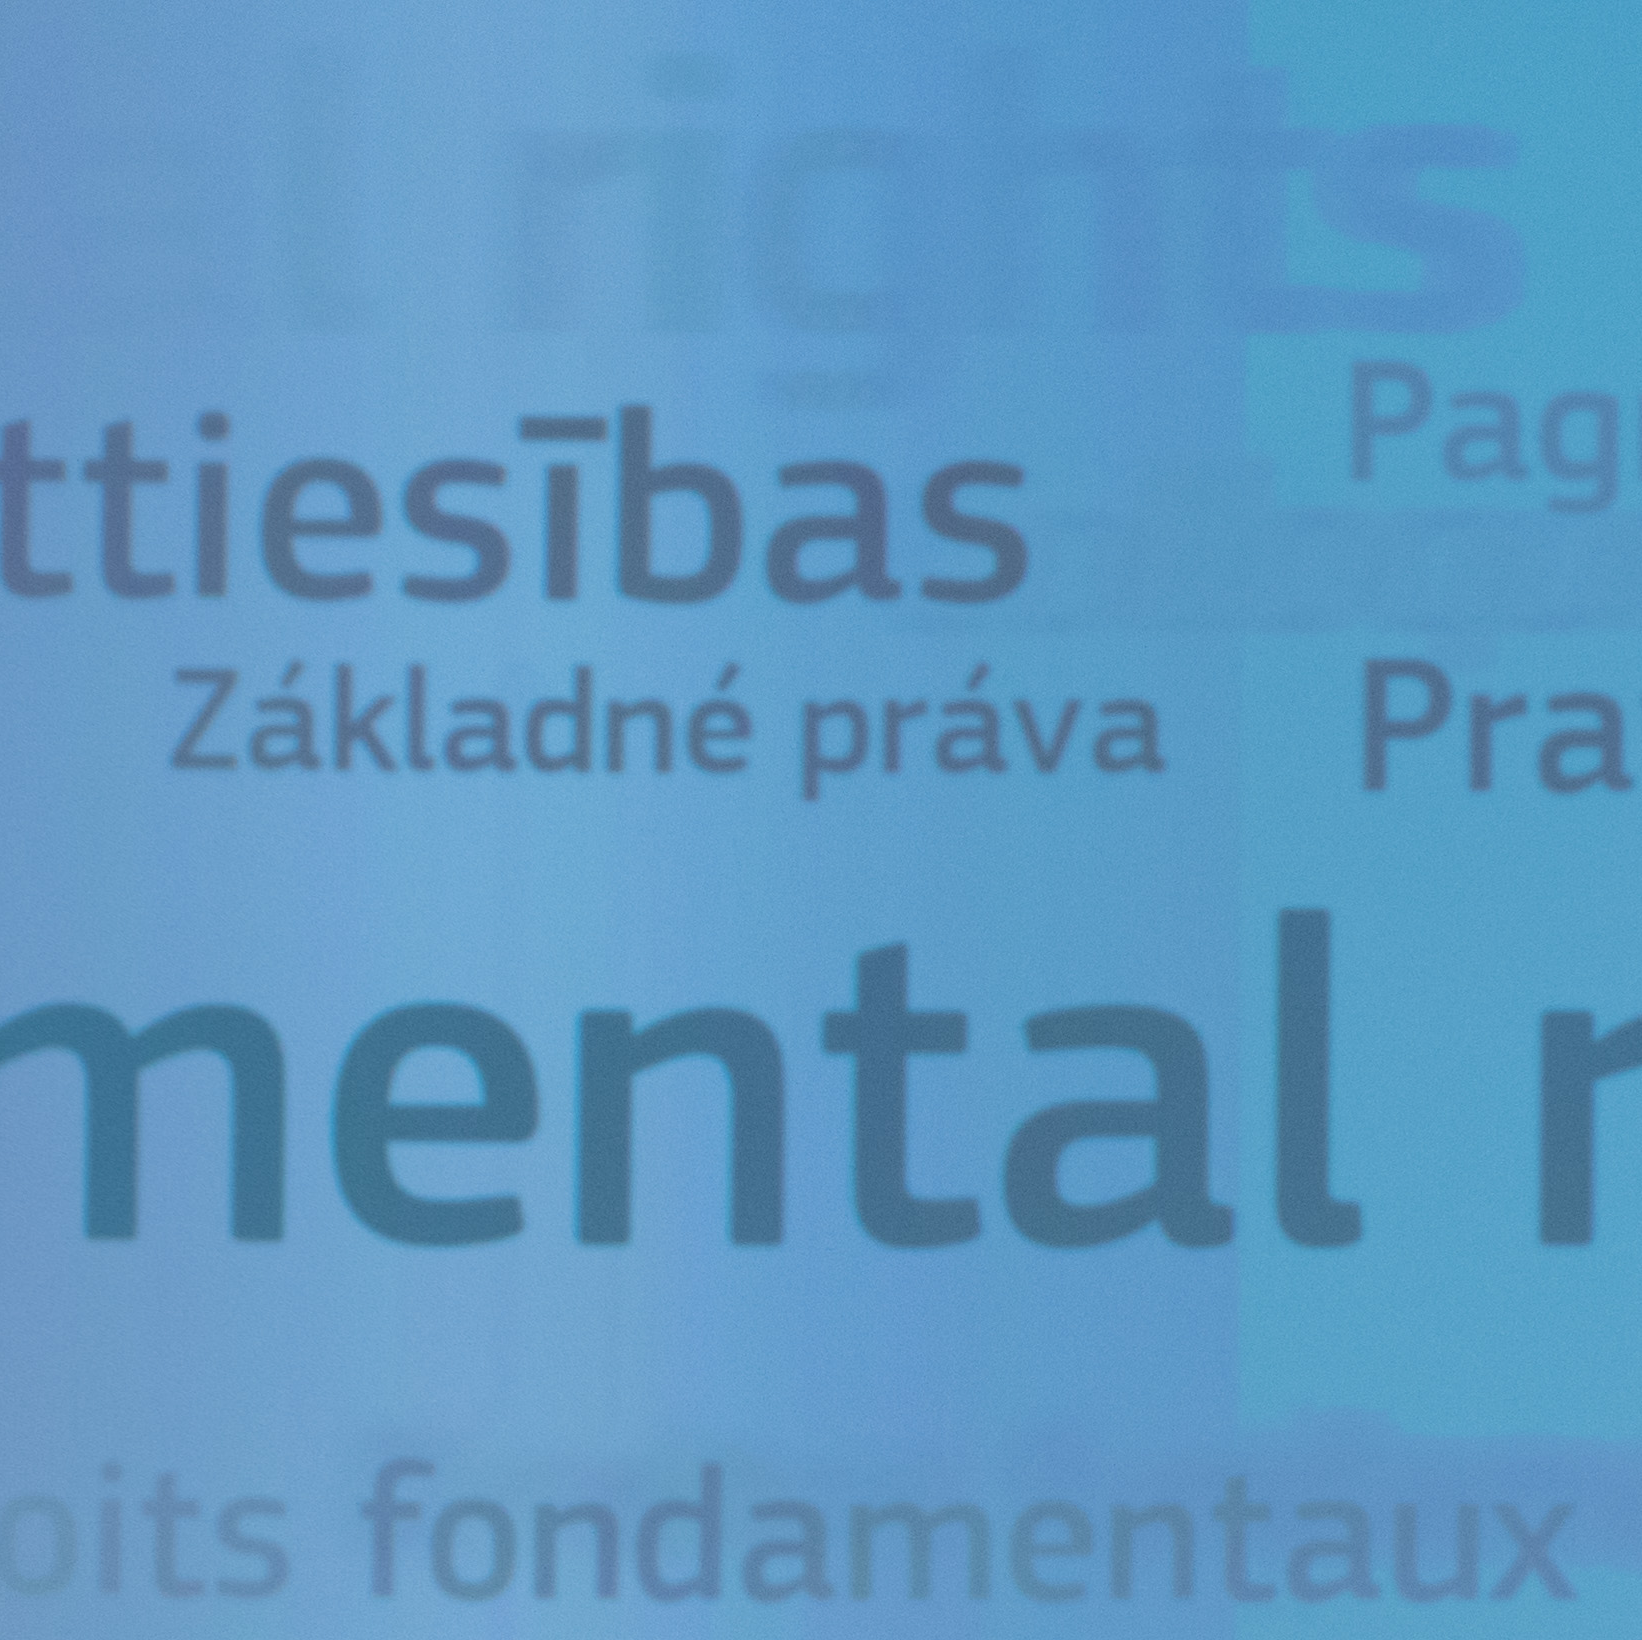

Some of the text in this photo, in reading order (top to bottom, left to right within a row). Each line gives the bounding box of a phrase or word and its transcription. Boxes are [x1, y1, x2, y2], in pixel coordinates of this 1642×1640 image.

[169, 660, 1168, 803] Základné práva
[358, 1454, 1575, 1606] fondamentaux
